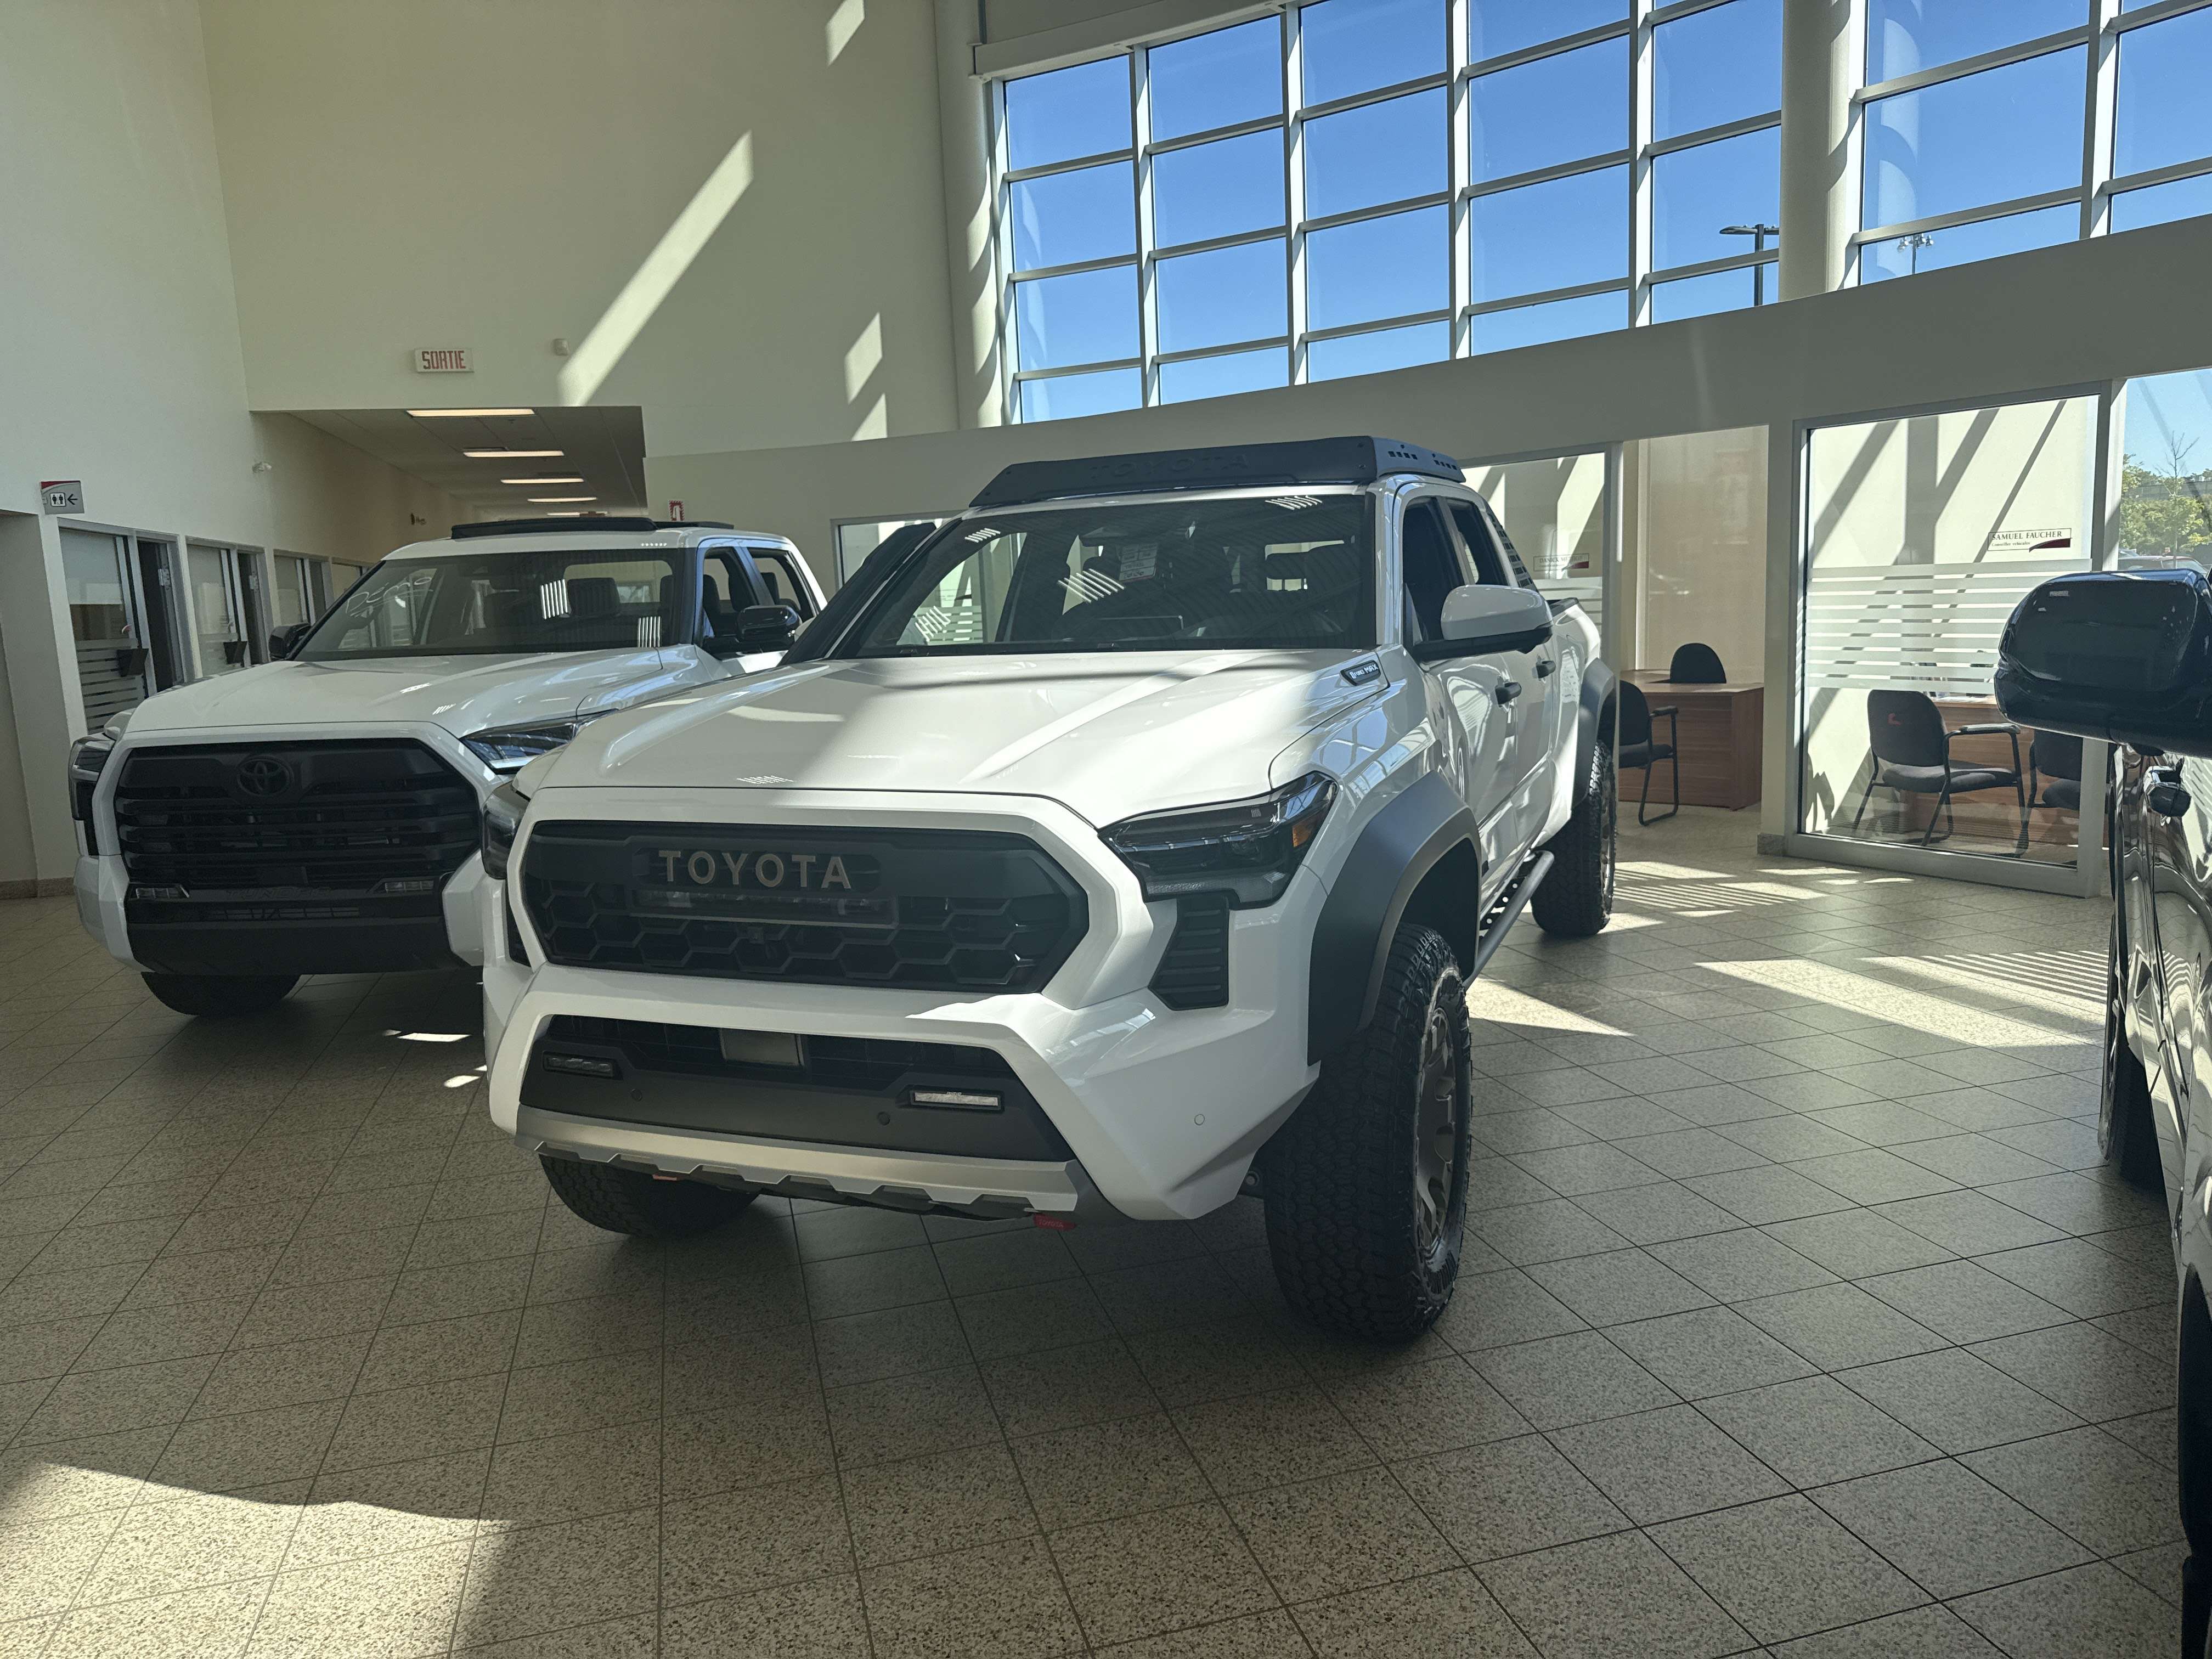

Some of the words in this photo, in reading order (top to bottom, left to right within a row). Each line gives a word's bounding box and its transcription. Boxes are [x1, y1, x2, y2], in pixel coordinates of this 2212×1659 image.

[421, 350, 466, 369] SORTIE
[1088, 454, 1251, 479] TOYOTA
[2026, 531, 2062, 539] FAUCHER
[1364, 664, 1378, 673] MAX
[658, 850, 851, 889] TOYOTA
